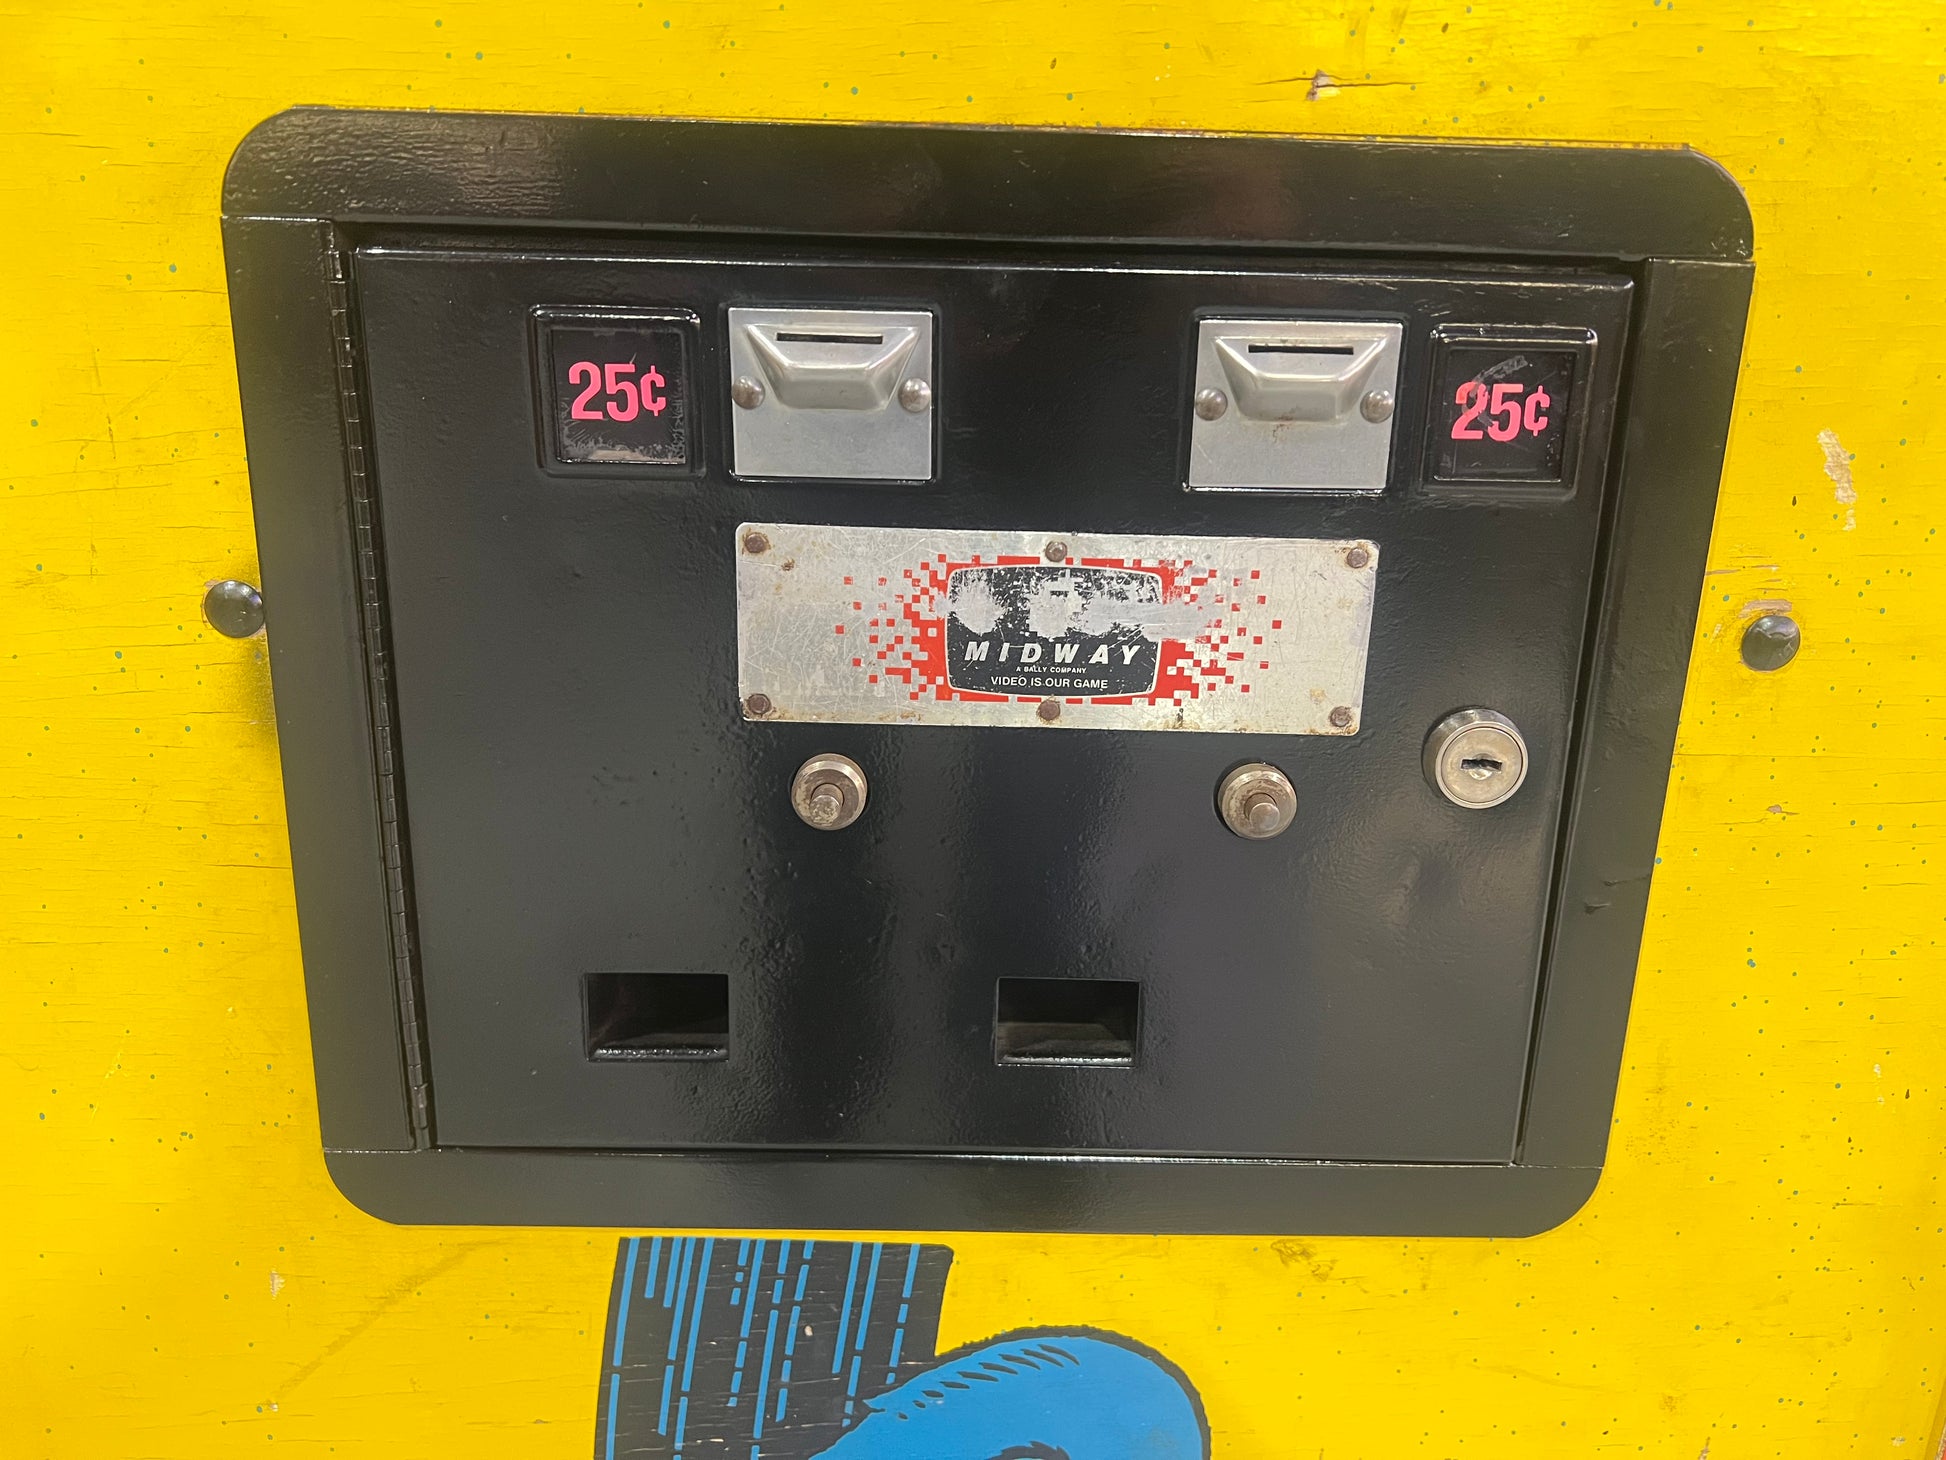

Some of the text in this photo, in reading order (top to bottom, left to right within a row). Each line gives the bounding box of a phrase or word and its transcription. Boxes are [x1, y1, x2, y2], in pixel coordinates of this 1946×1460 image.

[568, 361, 667, 422] 25¢
[1451, 381, 1551, 442] 25¢
[964, 640, 1141, 665] MIDWAY
[991, 676, 1108, 689] VIDEO IS OUR GAME
[1049, 666, 1087, 674] COMPANY
